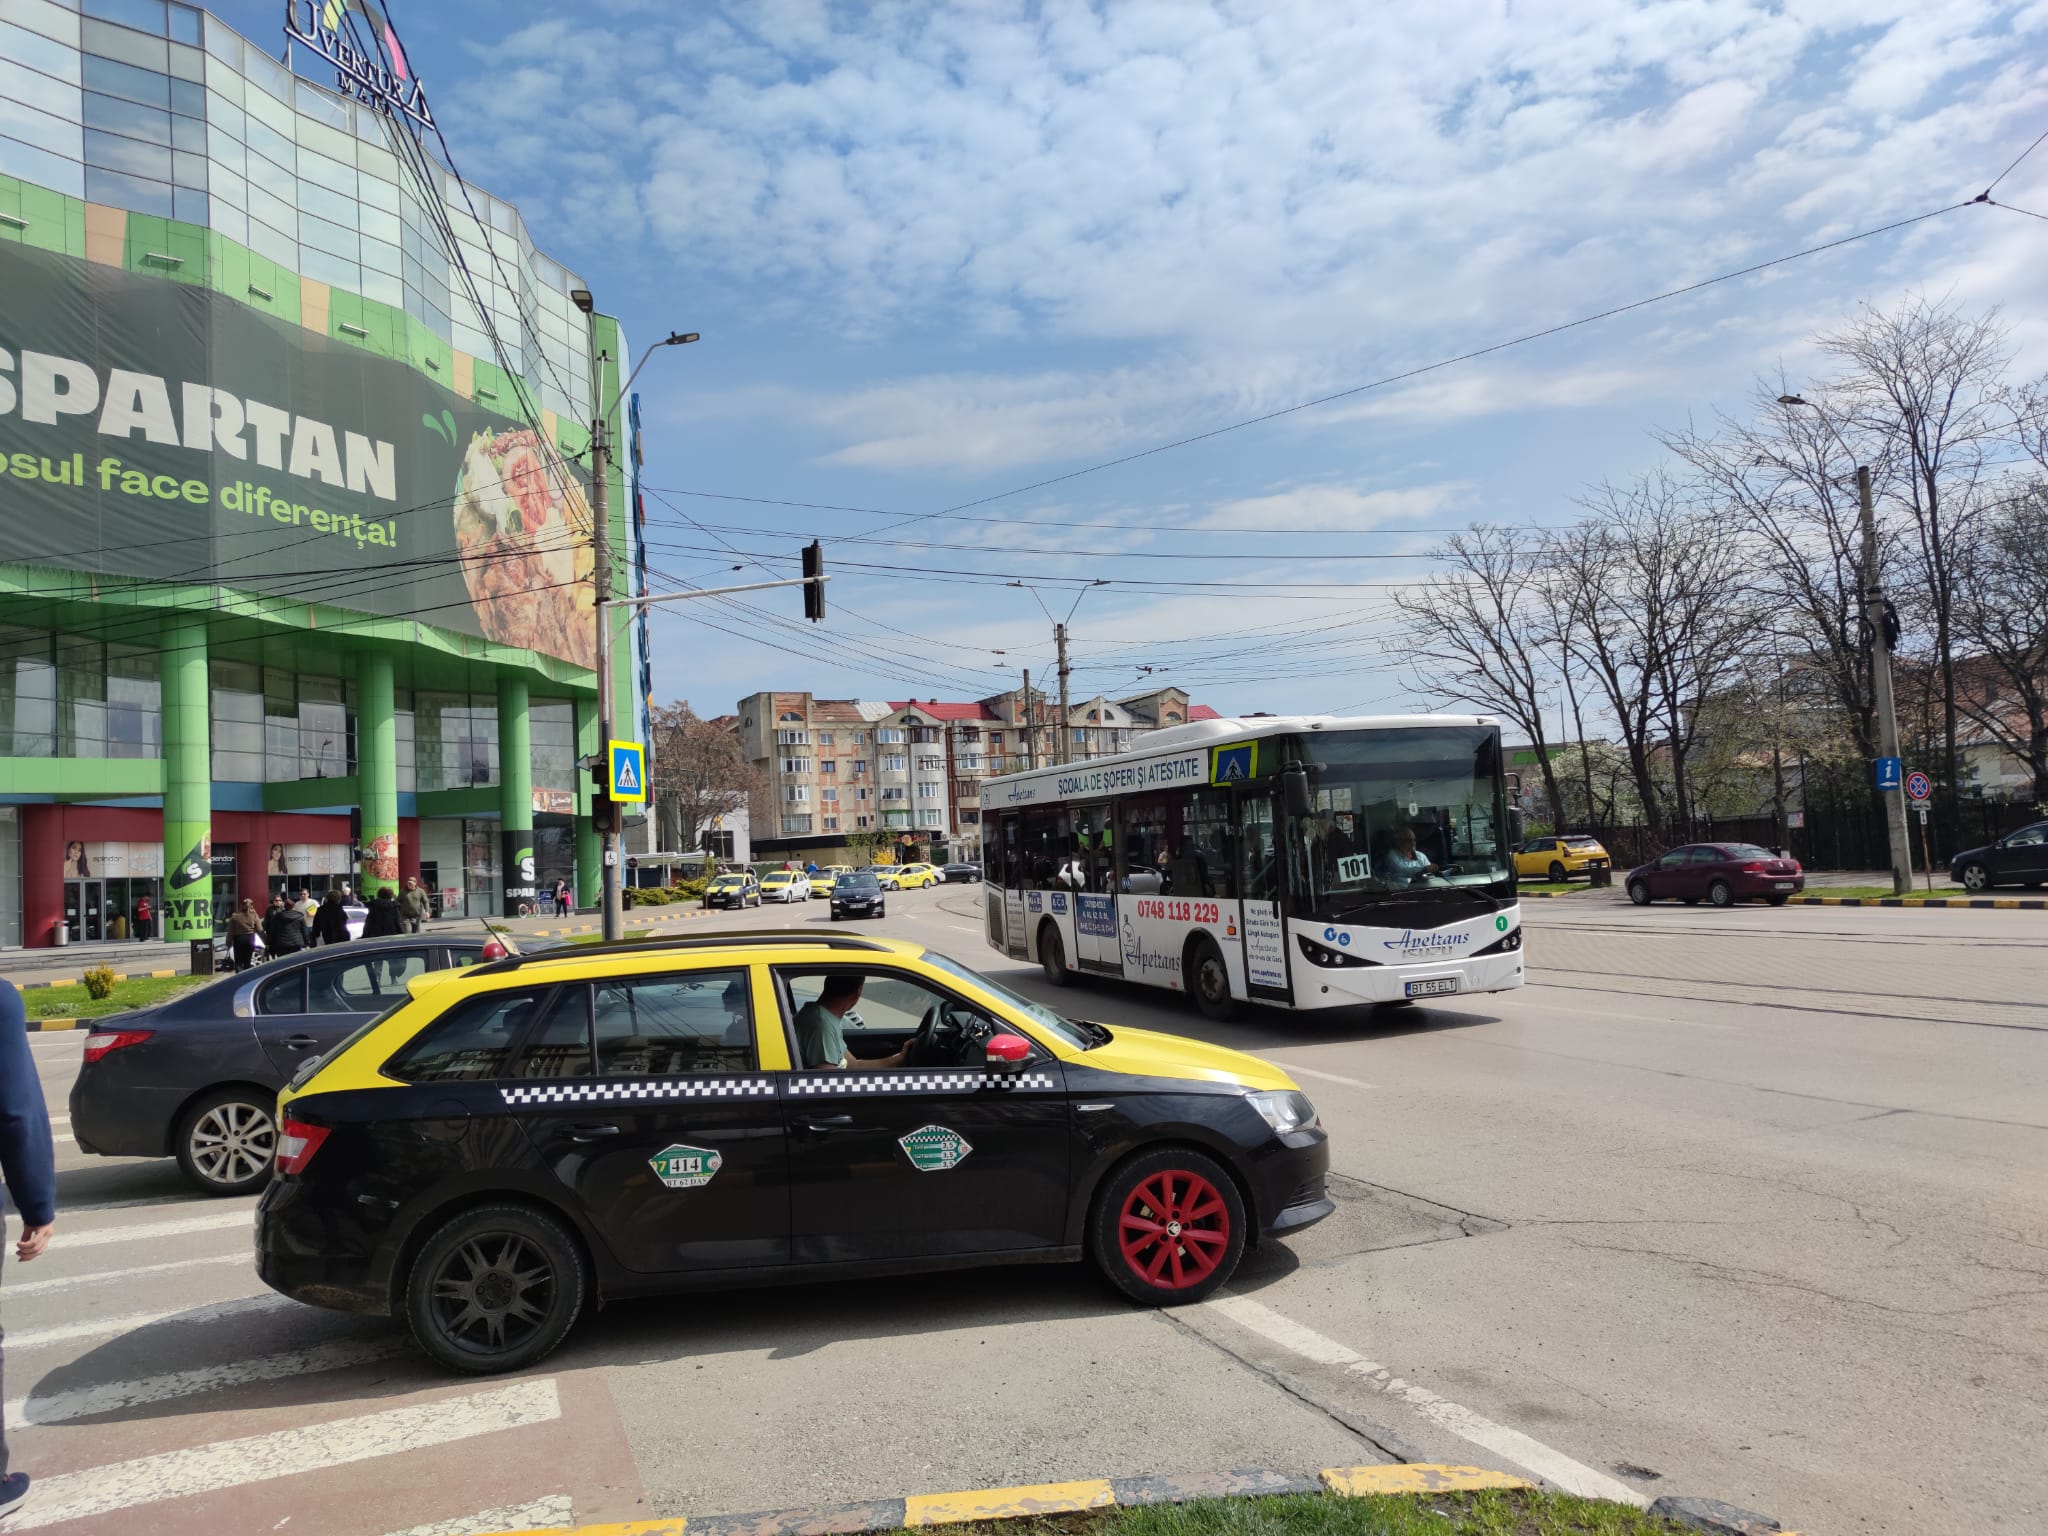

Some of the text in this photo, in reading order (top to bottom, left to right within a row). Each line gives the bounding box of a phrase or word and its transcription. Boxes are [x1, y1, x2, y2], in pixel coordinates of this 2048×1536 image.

[97, 457, 209, 504] face
[220, 480, 397, 550] diferența!
[1058, 776, 1090, 799] ȘCOALA
[1091, 775, 1102, 790] DE
[1104, 767, 1136, 793] ȘOFERI
[1149, 757, 1199, 782] ATESTATE
[1341, 857, 1369, 879] 101
[1137, 900, 1219, 924] 0748 118 229
[173, 919, 194, 931] LA
[1126, 936, 1180, 975] Apetrans
[1411, 980, 1455, 995] BT 55 ELT
[671, 1157, 699, 1172] 414
